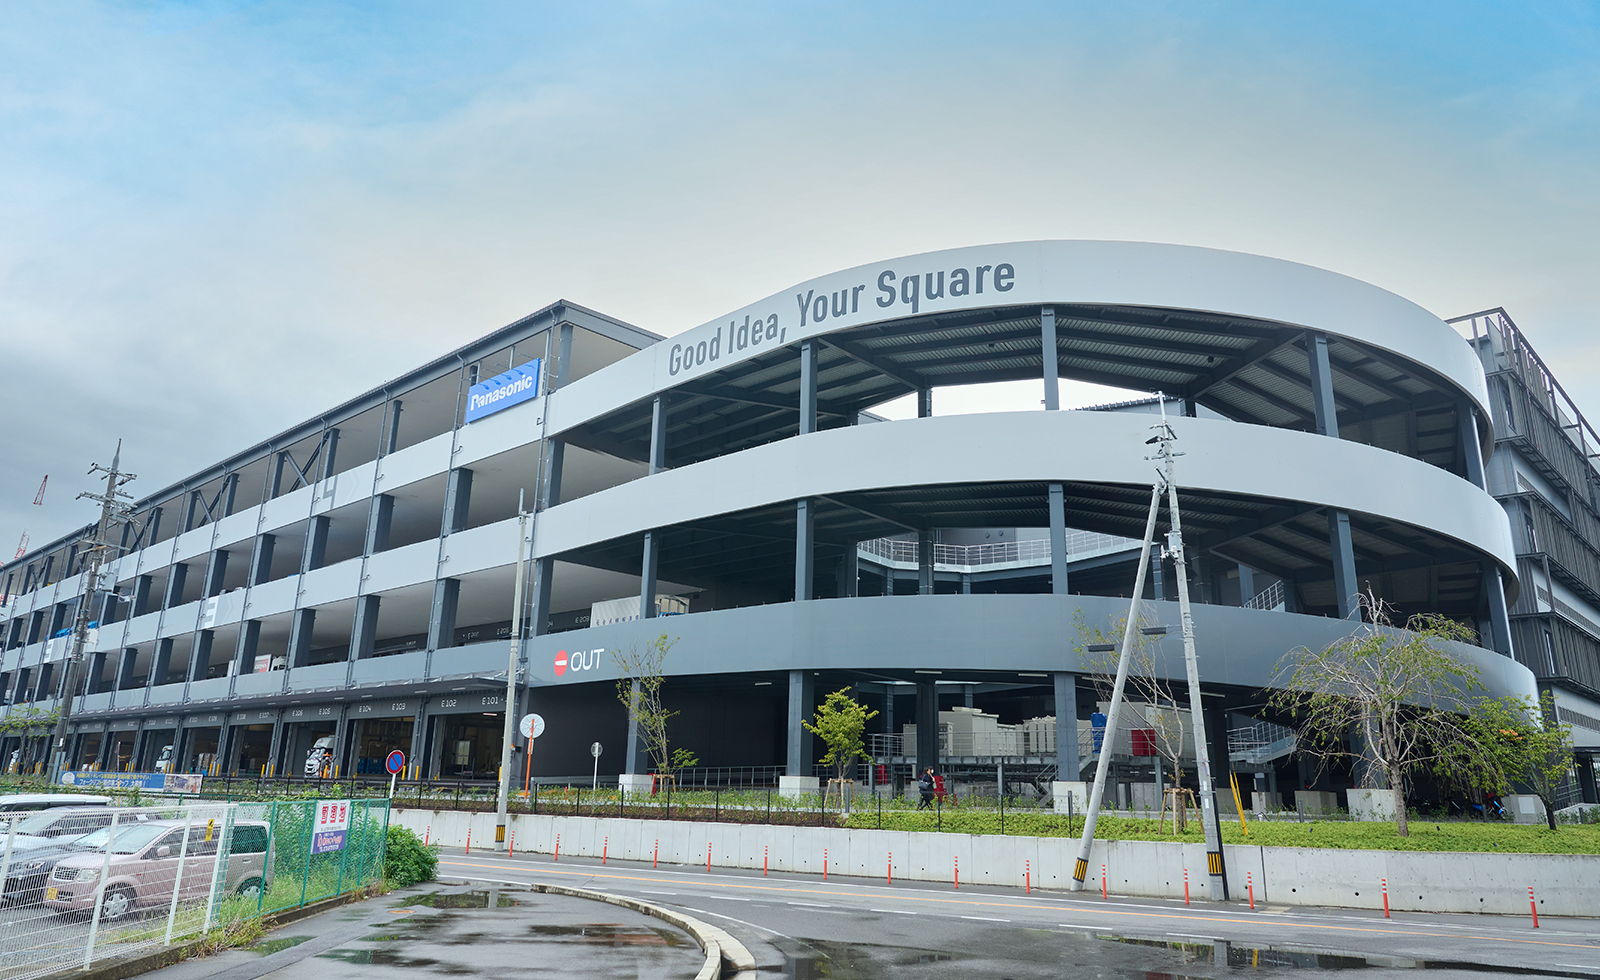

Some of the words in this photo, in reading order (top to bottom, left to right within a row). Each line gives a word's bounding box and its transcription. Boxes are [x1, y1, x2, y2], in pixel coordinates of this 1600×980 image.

[668, 326, 723, 377] Good
[727, 312, 788, 355] Idea,
[796, 284, 866, 328] Your
[875, 262, 1016, 314] Square
[470, 374, 533, 411] Panasonic
[570, 648, 605, 672] OUT
